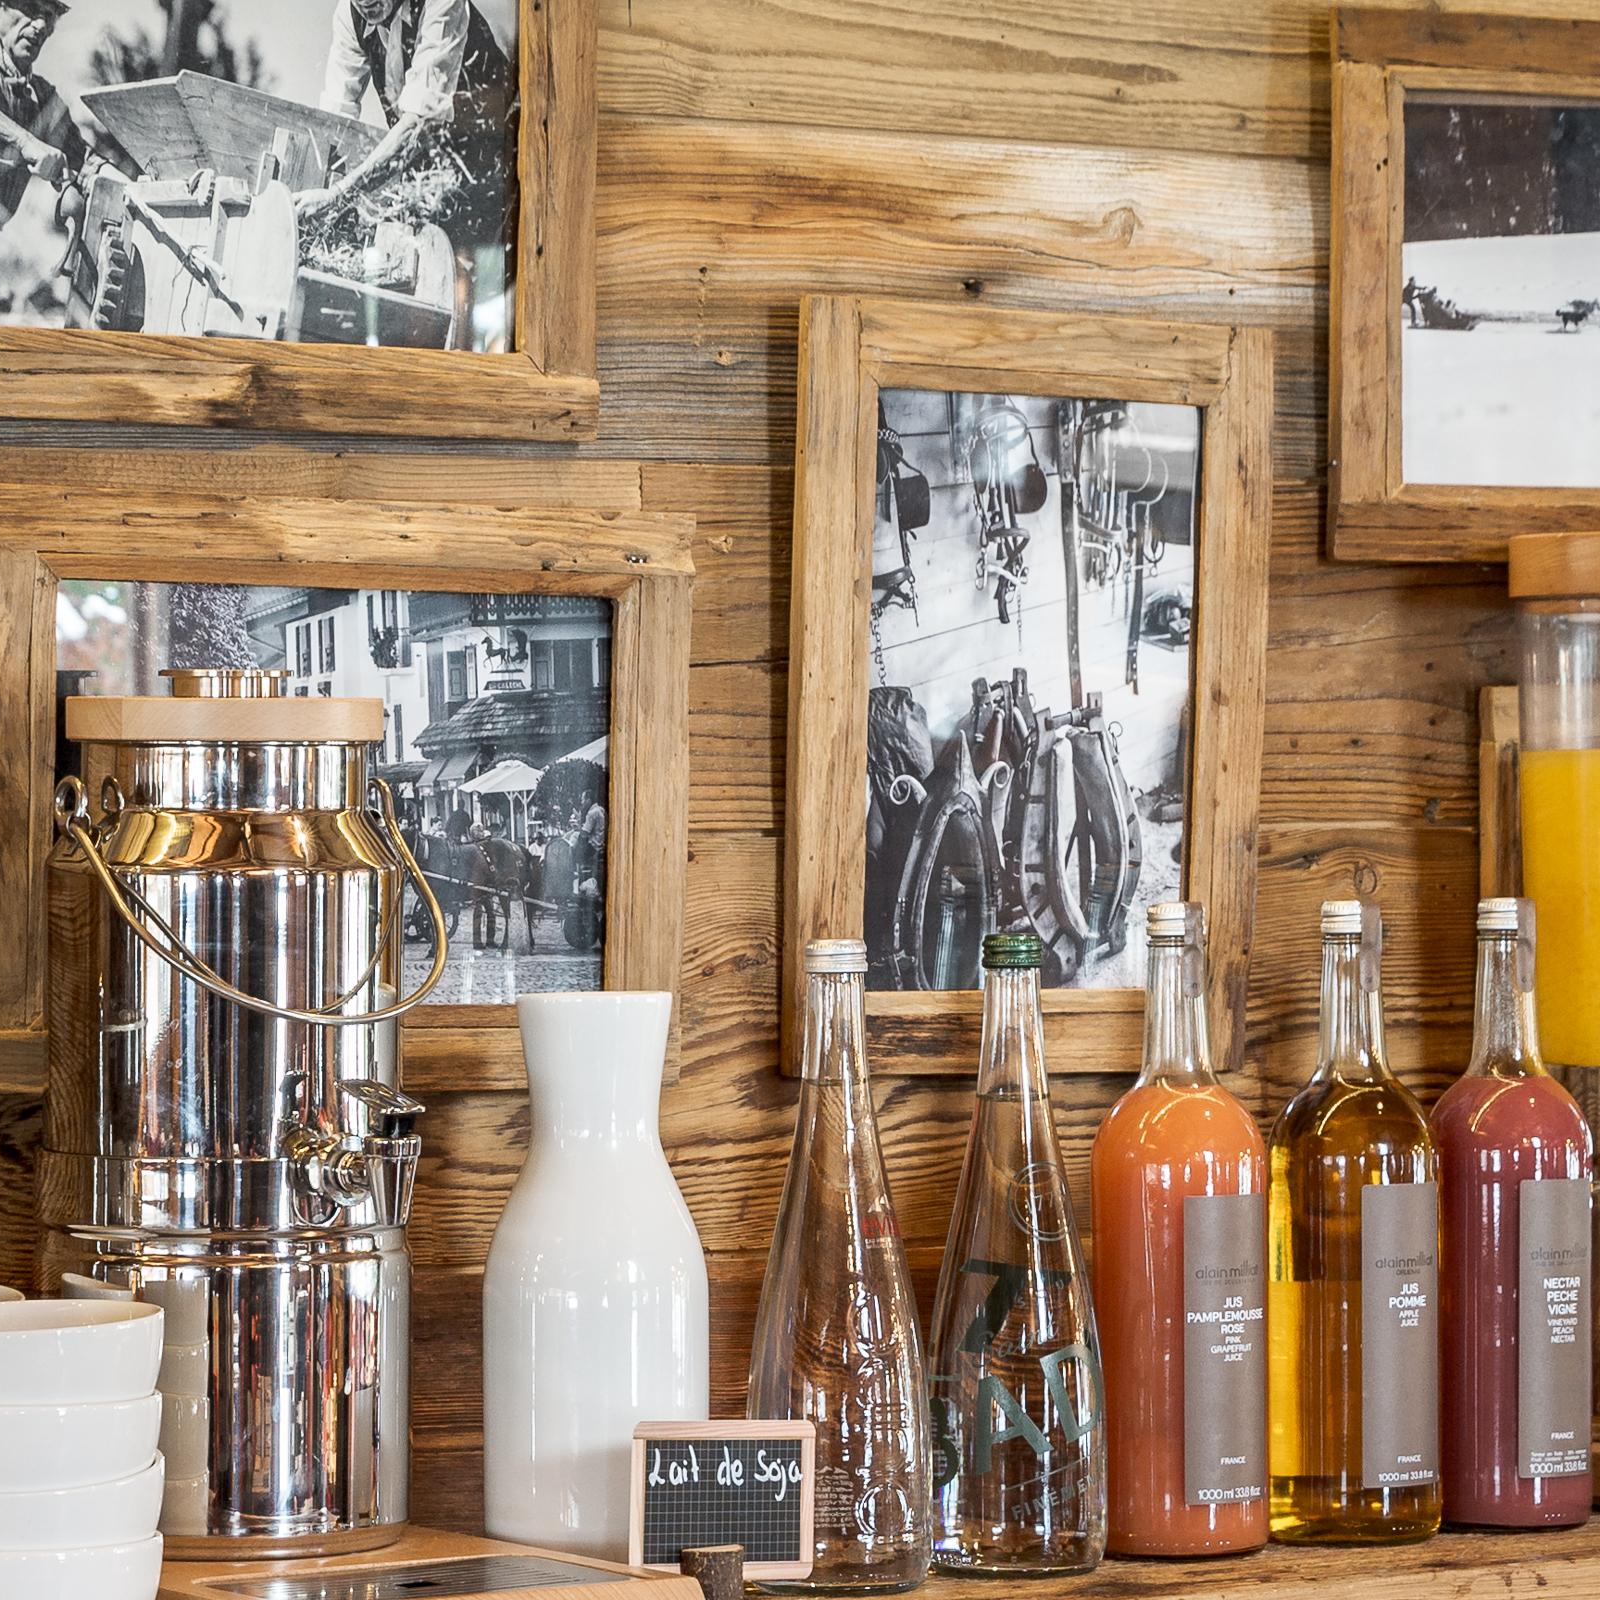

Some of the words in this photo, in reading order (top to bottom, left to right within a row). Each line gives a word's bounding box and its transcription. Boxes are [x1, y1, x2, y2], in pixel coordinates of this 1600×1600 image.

[1543, 1276, 1580, 1289] NECTAR
[1400, 1283, 1419, 1295] JUS
[1388, 1295, 1426, 1308] POMME
[1547, 1290, 1578, 1302] PECHE
[1223, 1296, 1243, 1308] JUS
[1399, 1309, 1419, 1318] APPLE
[1548, 1303, 1578, 1315] VIGNE
[1187, 1308, 1263, 1323] PAMPLEMOUSSE
[1400, 1319, 1418, 1327] JUICE
[1547, 1317, 1578, 1326] VINEYARD
[1220, 1323, 1245, 1334] ROSE
[1552, 1327, 1574, 1335] PEACH
[1225, 1335, 1241, 1344] PINK
[1550, 1334, 1575, 1344] NECTAR
[1210, 1343, 1252, 1354] GRAPEFRUIT
[1224, 1353, 1243, 1362] JUICE
[1551, 1431, 1575, 1440] FRANCE
[1220, 1456, 1246, 1465] FRANCE
[1397, 1454, 1421, 1464] FRANCE
[649, 1444, 700, 1487] Lait
[717, 1445, 744, 1487] de
[754, 1449, 803, 1502] Soja
[1529, 1463, 1553, 1474] 1000
[1553, 1463, 1563, 1472] ml
[1378, 1473, 1399, 1482] 1000
[1400, 1472, 1409, 1480] ml
[1198, 1489, 1223, 1500] 1000
[1224, 1489, 1234, 1499] ml
